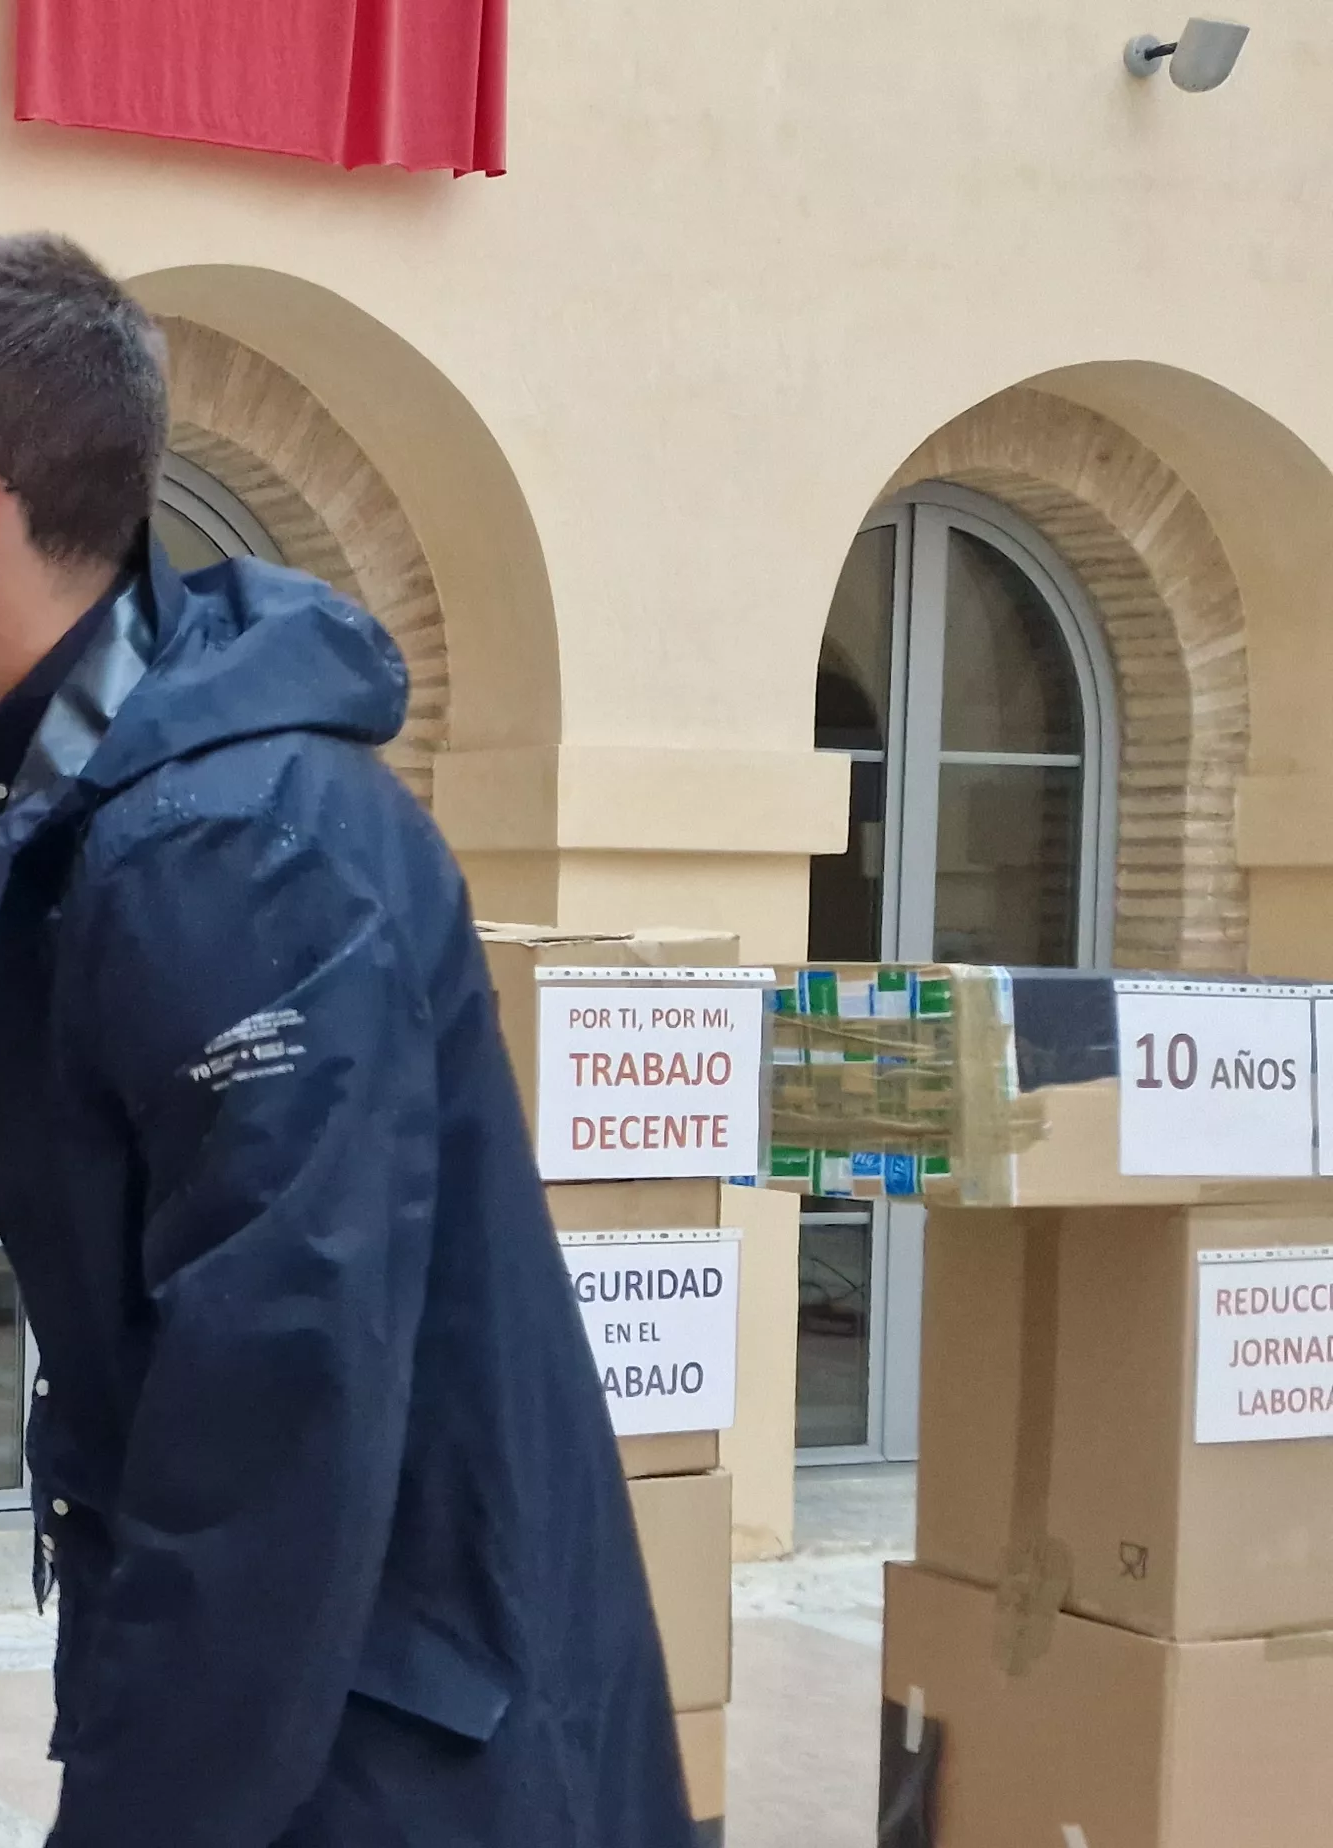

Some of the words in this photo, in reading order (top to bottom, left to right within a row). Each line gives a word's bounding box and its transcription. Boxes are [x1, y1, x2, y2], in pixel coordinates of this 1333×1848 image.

[569, 1008, 611, 1029] POR
[618, 1008, 643, 1031] TI,
[652, 1008, 695, 1028] POR
[703, 1008, 735, 1031] MI,
[569, 1051, 732, 1086] TRABAJO
[1136, 1033, 1198, 1089] 10
[1210, 1050, 1296, 1090] AÑOS
[572, 1115, 729, 1150] DECENTE
[568, 1268, 723, 1303] GURIDAD
[604, 1323, 631, 1343] EN
[639, 1321, 660, 1342] EL
[603, 1362, 704, 1398] ABAJO
